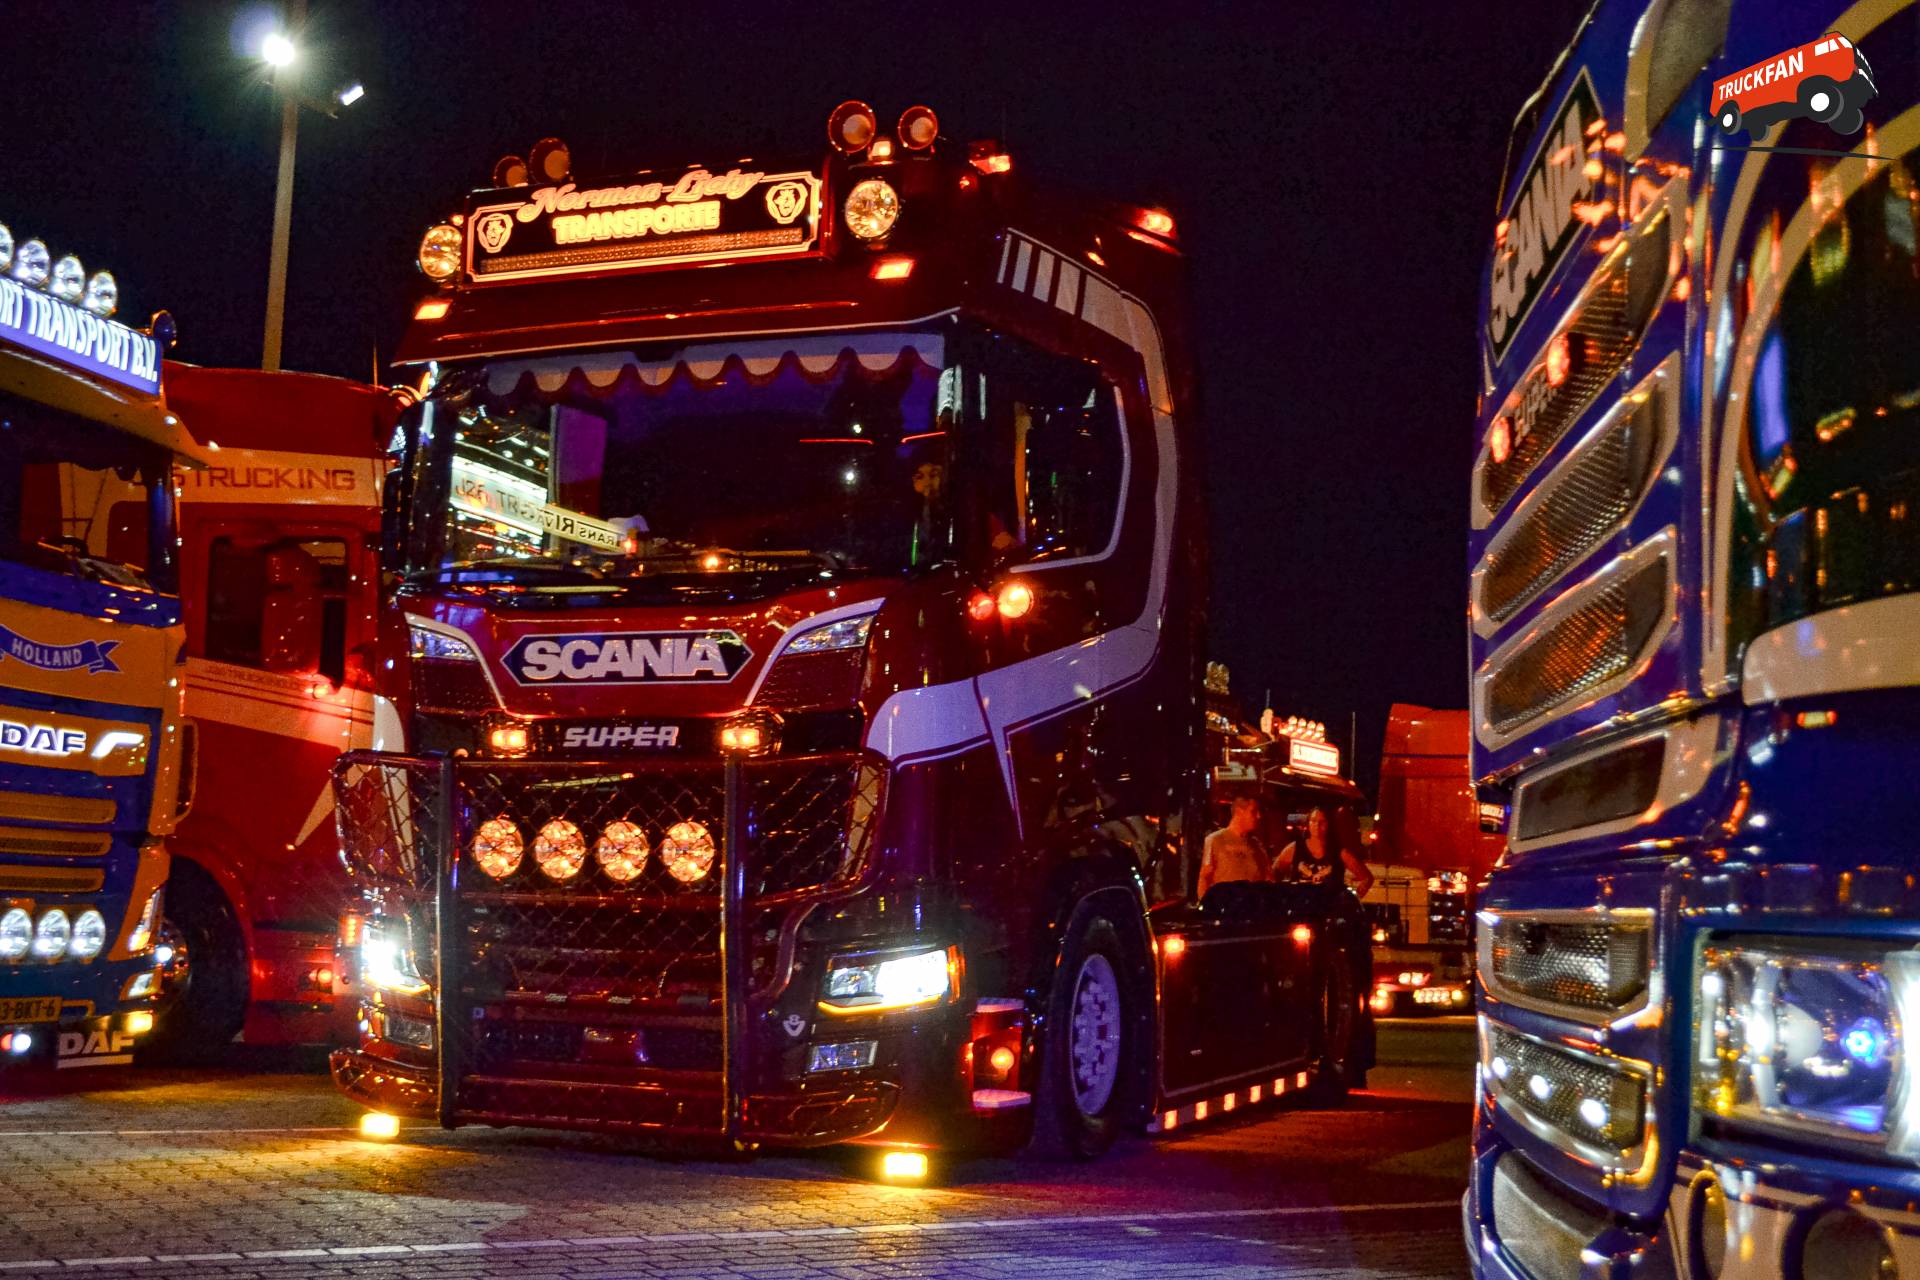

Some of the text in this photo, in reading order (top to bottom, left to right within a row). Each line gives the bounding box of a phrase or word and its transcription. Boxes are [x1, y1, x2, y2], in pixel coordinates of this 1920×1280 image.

[552, 201, 721, 245] TRANSPORTE
[1490, 101, 1592, 344] SCANIA
[24, 288, 130, 371] TRANSPORT
[130, 333, 158, 383] B.V.
[11, 638, 82, 666] HOLLAND
[521, 638, 728, 680] SCANIA
[0, 721, 86, 755] DAF
[563, 726, 679, 748] SUPER
[58, 1031, 134, 1056] DAF
